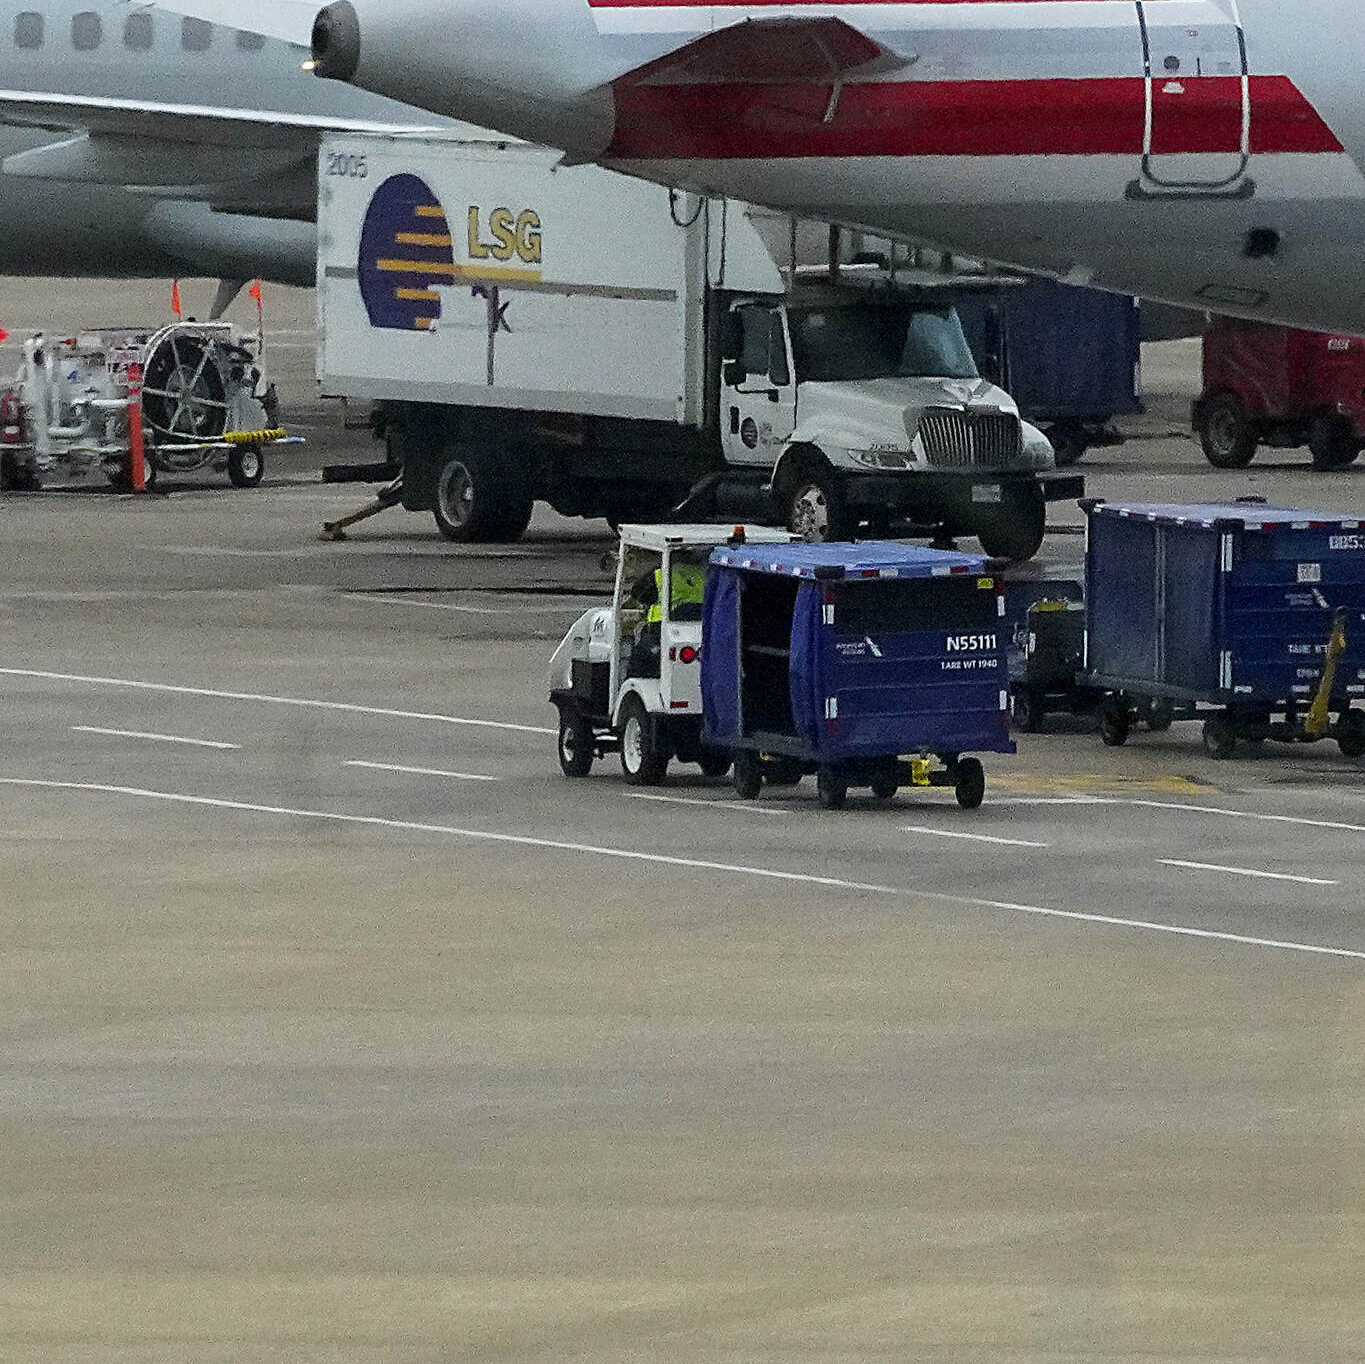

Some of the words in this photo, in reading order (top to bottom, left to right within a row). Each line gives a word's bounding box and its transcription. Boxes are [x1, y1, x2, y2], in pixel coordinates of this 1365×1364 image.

[467, 205, 543, 264] LSG
[946, 634, 997, 651] N55111
[963, 659, 977, 669] WT
